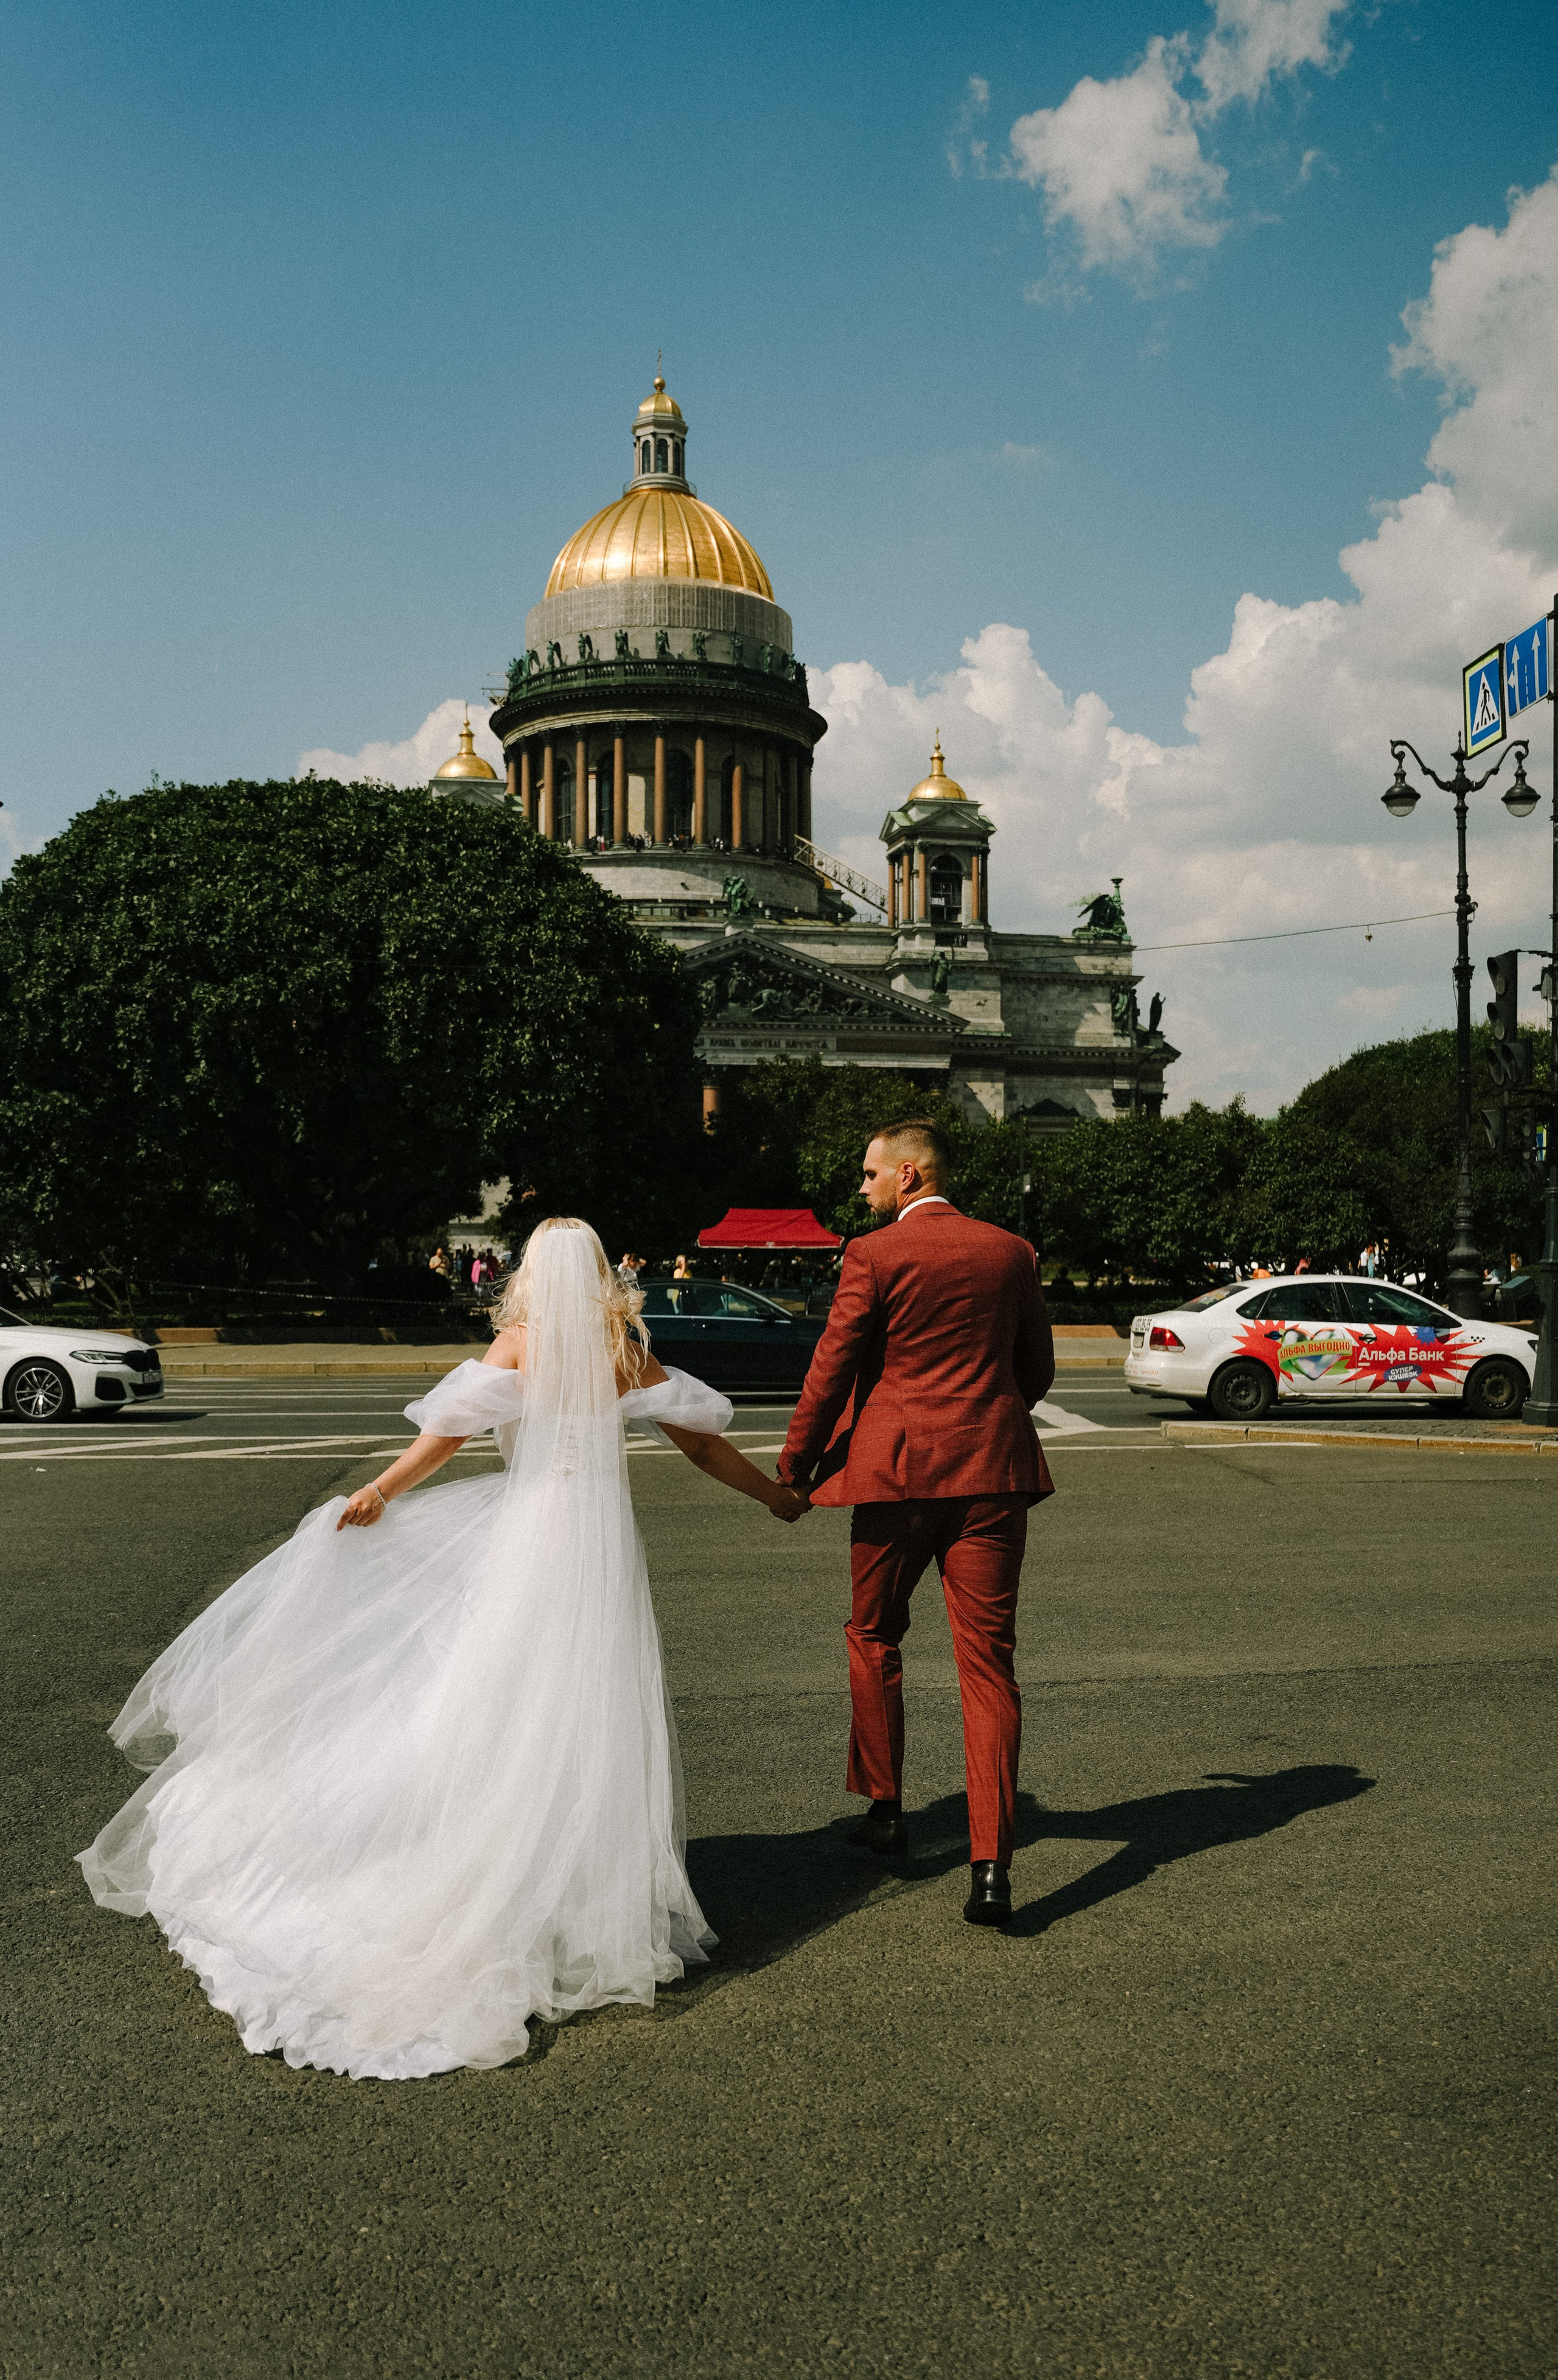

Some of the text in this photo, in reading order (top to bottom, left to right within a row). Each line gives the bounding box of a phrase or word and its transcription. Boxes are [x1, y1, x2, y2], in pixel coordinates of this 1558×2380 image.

[1280, 1341, 1350, 1359] АЛЬФА ВЫГОДНО
[1358, 1347, 1445, 1365] Альфа Банк
[1388, 1370, 1419, 1381] КЭШБЭК
[1390, 1366, 1414, 1375] СУПЕР
